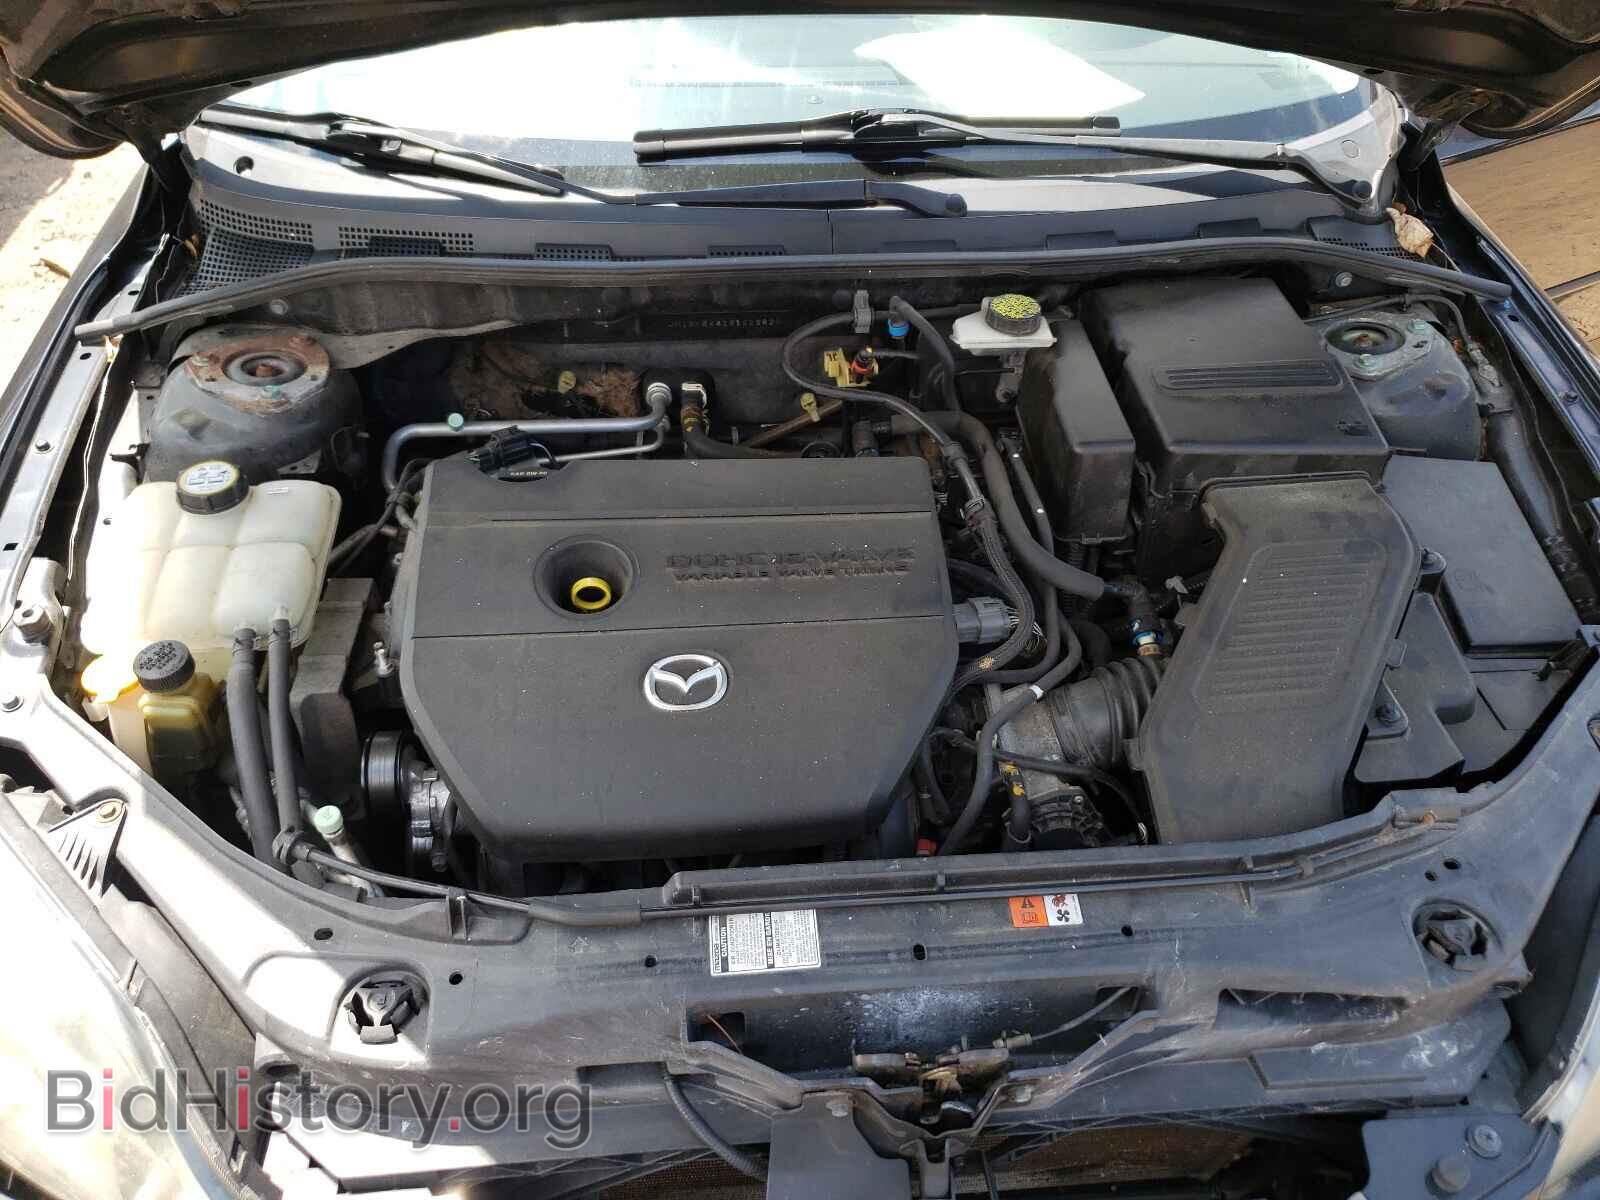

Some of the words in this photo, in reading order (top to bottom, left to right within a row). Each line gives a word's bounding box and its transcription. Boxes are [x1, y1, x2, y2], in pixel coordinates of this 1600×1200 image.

[673, 570, 769, 582] VARIABLE
[778, 567, 834, 578] VALVE
[720, 926, 728, 958] CAUTION
[766, 937, 773, 947] EN
[766, 947, 774, 965] MISE
